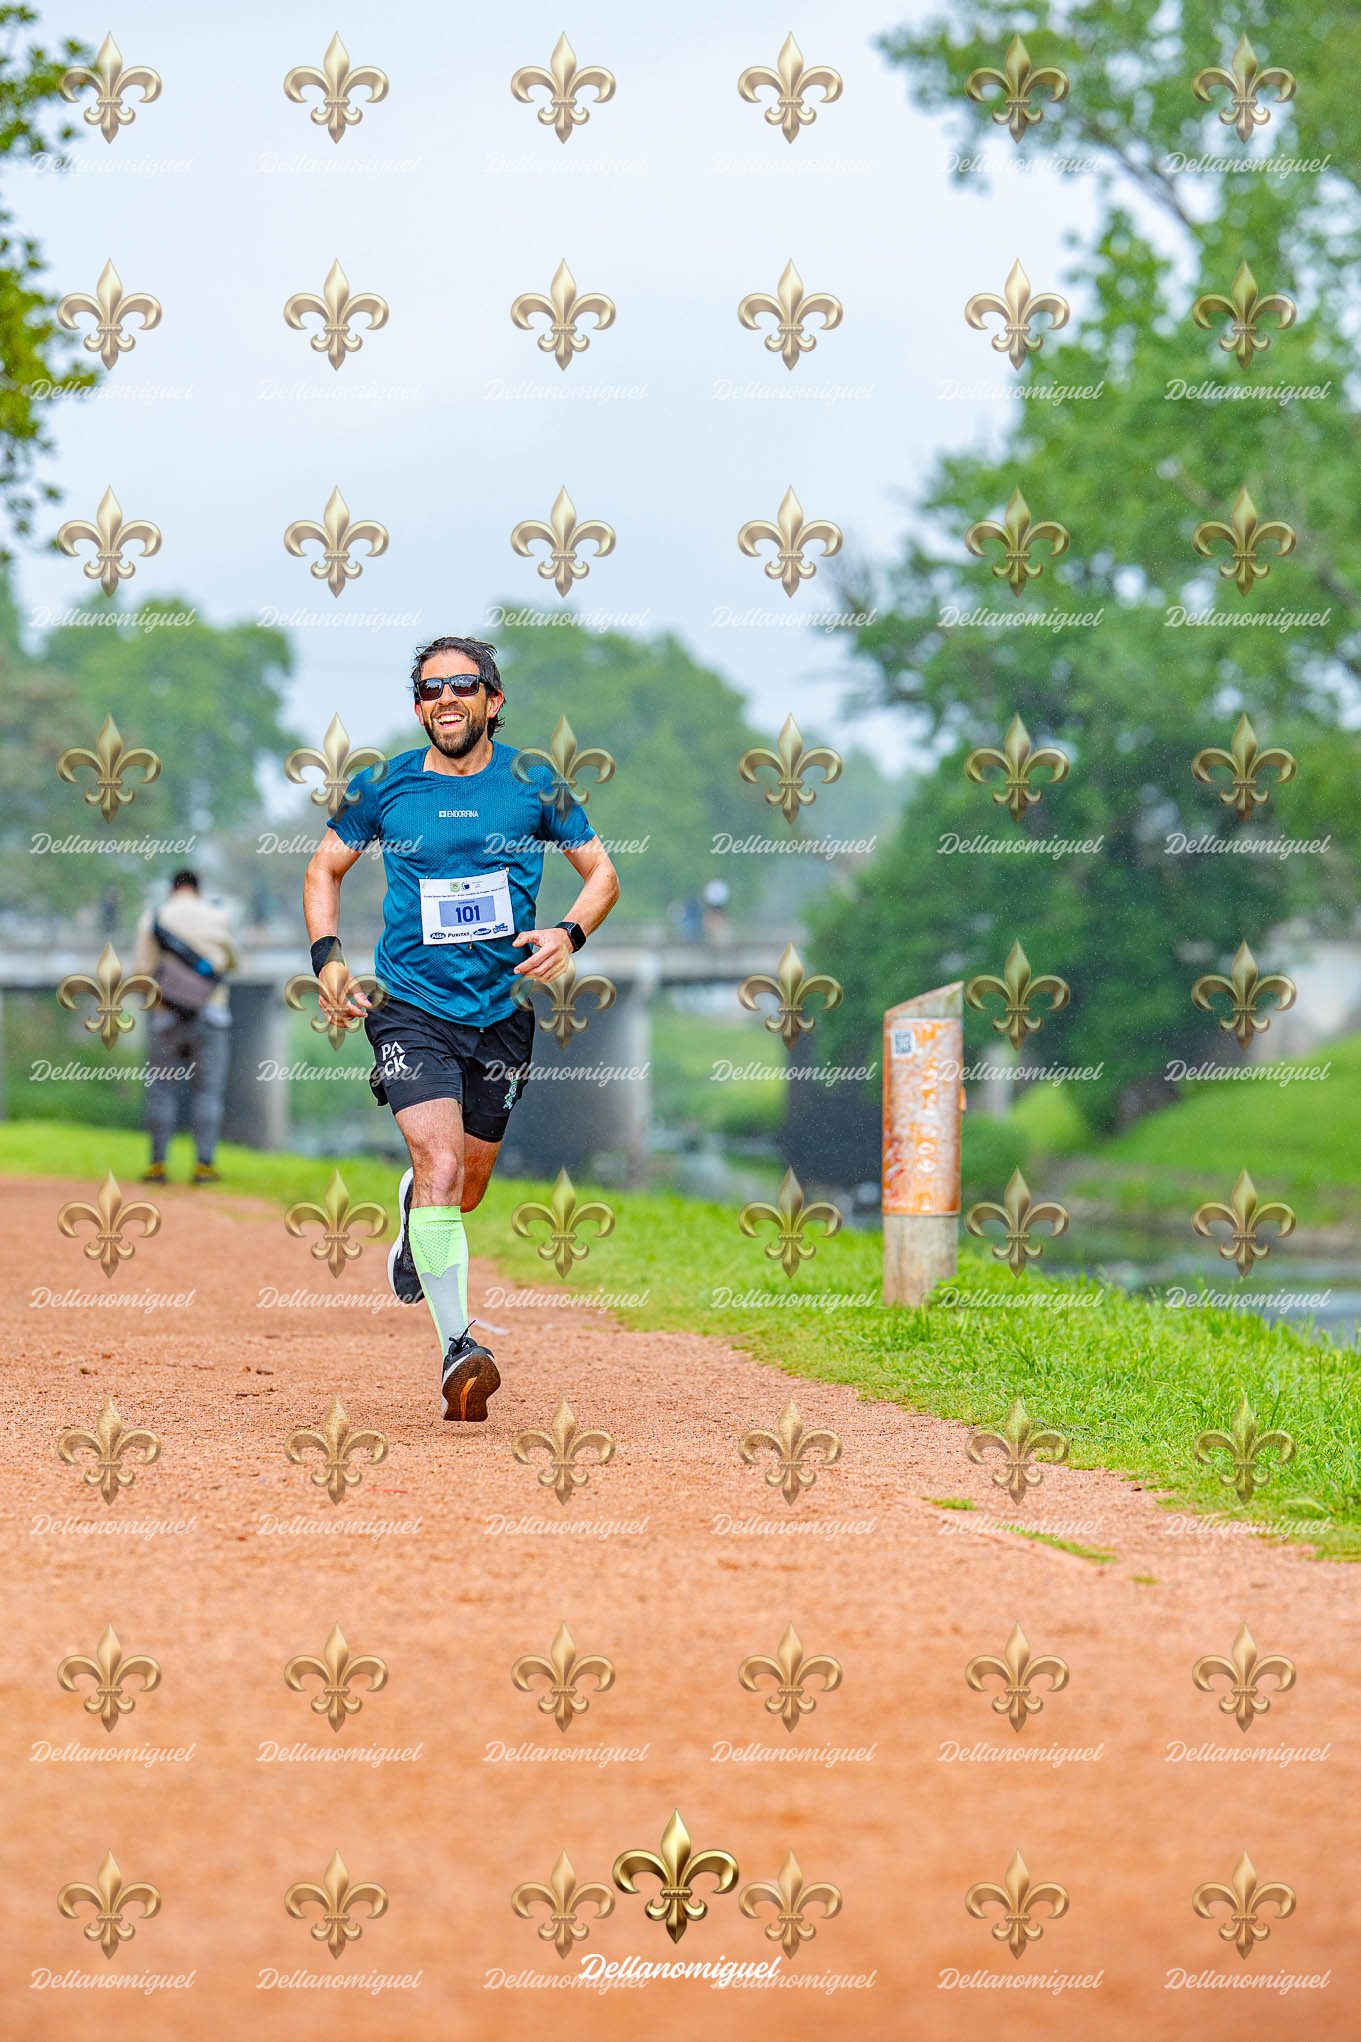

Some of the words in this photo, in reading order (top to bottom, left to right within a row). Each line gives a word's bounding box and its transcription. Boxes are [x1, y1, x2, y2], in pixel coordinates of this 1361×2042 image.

[447, 810, 479, 818] ENDORFINA
[456, 905, 480, 923] 101
[381, 1041, 405, 1061] PA
[384, 1054, 408, 1076] CK
